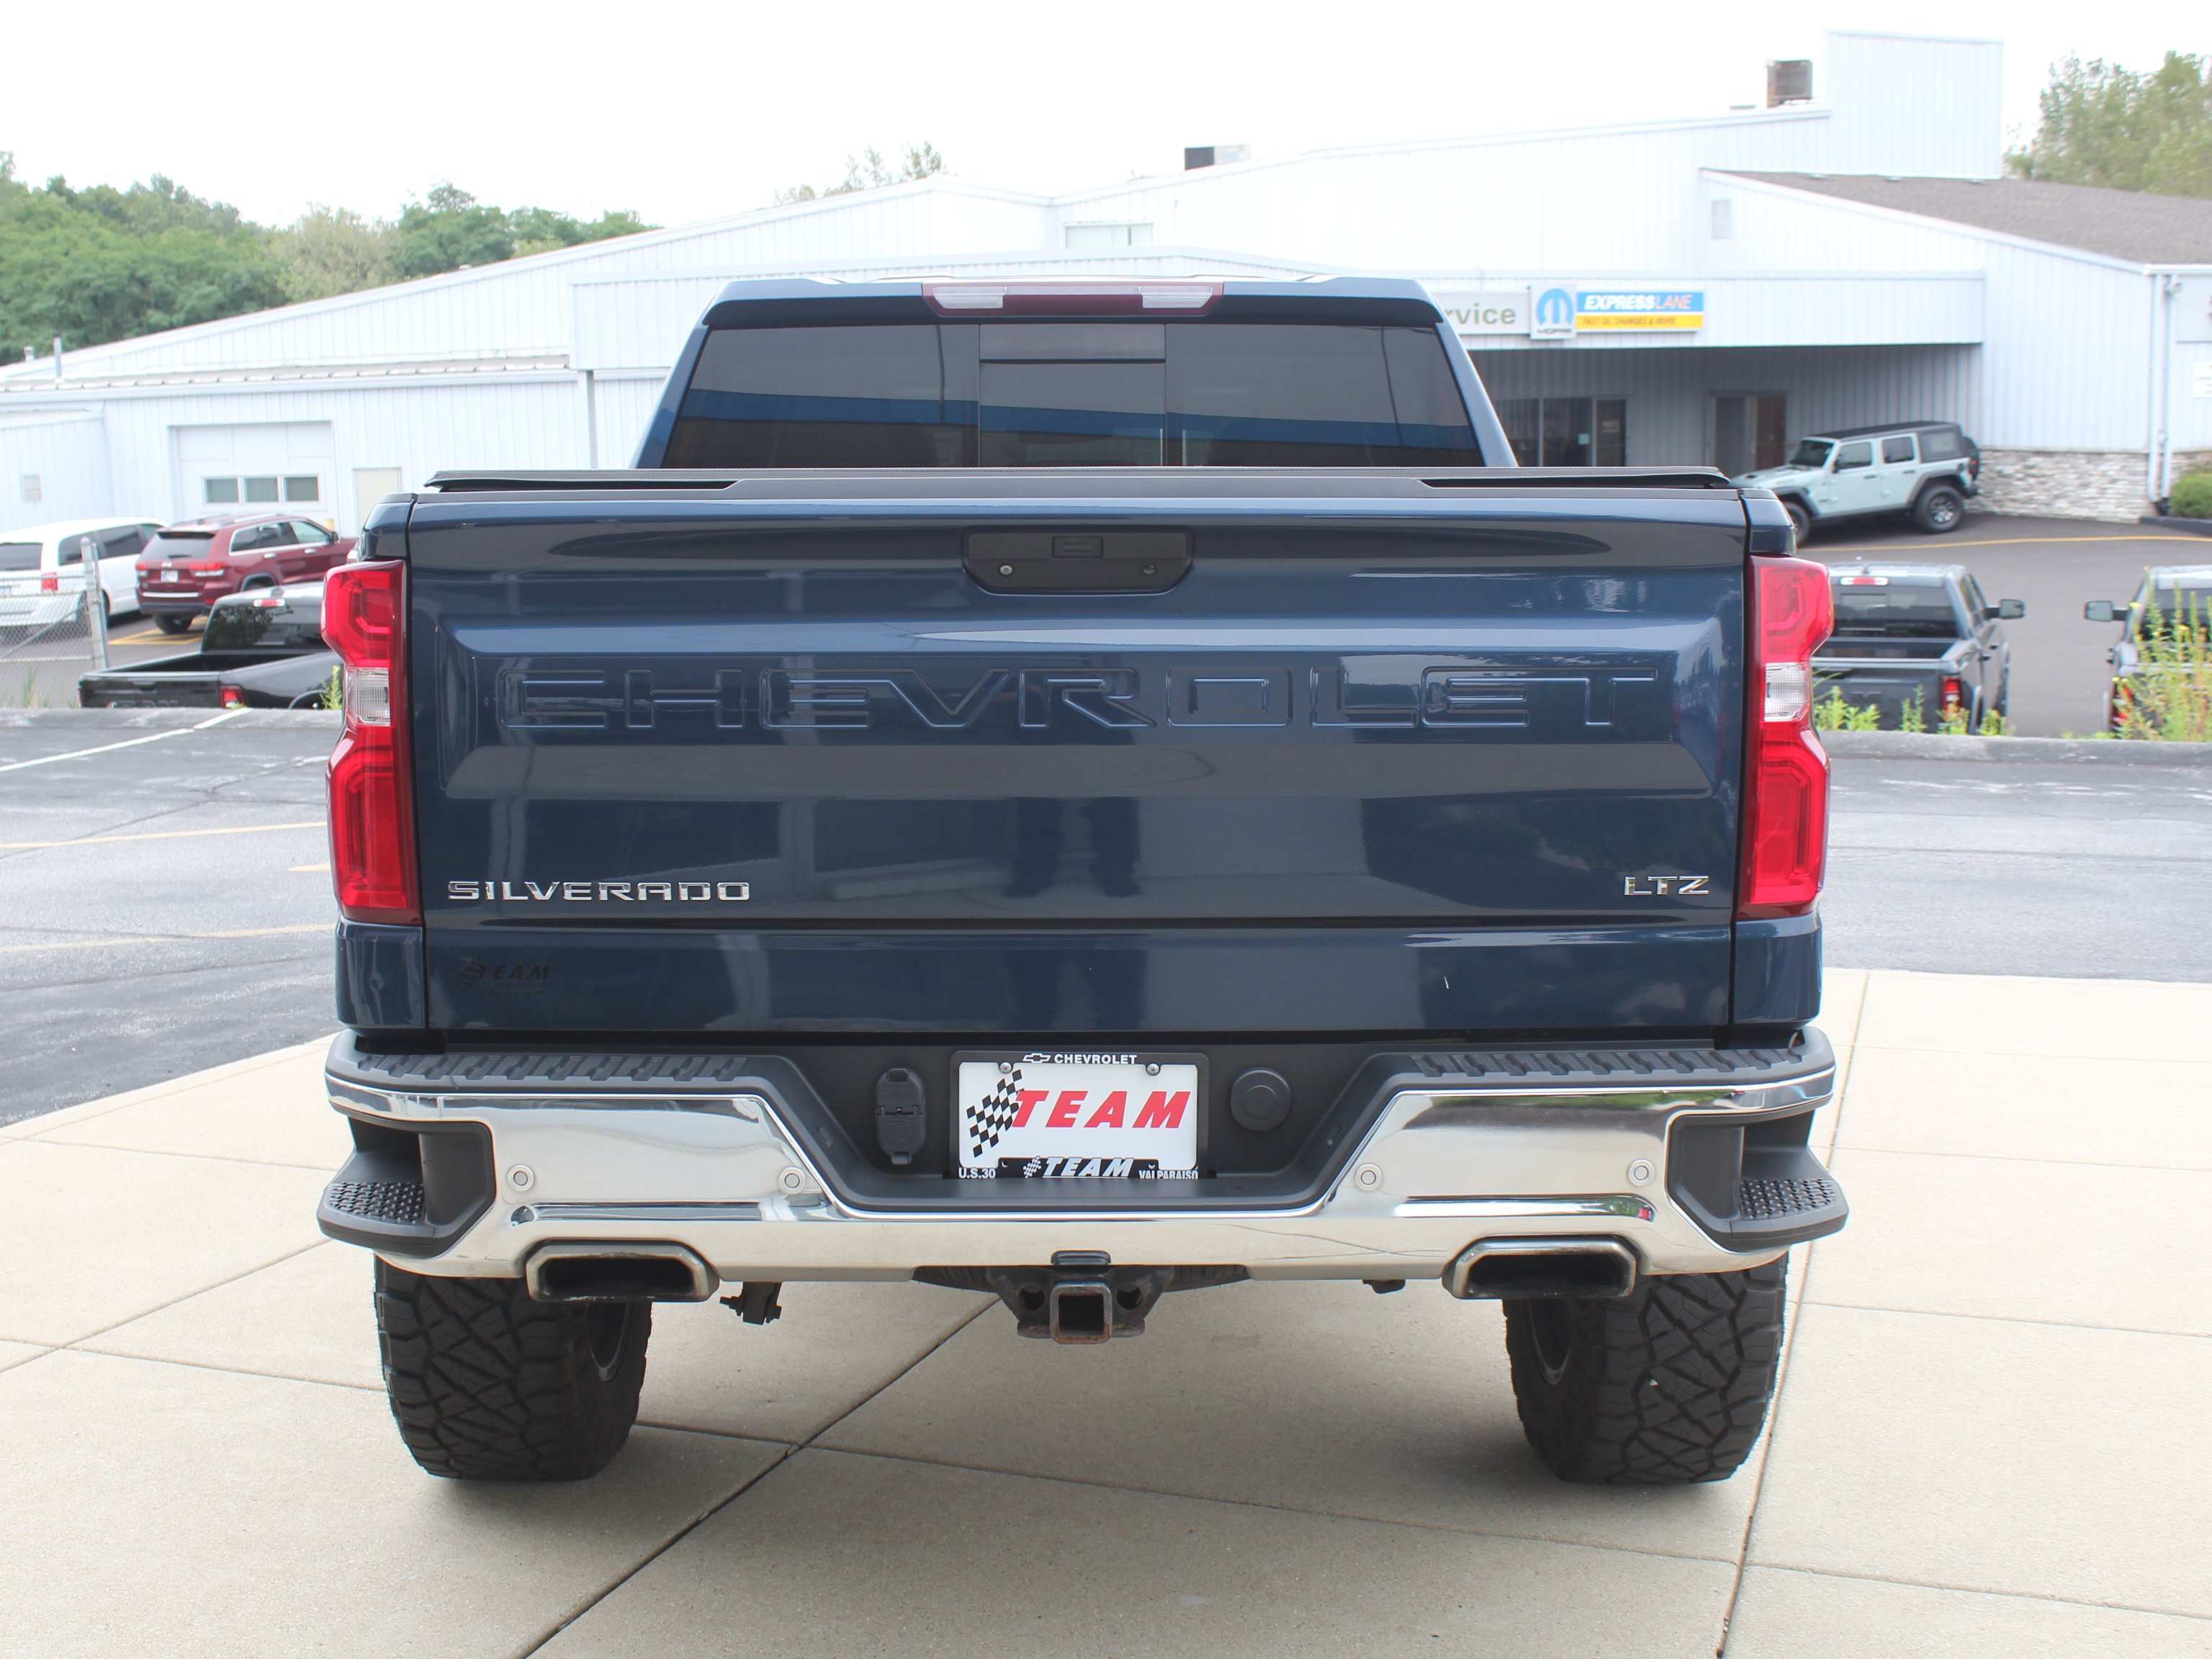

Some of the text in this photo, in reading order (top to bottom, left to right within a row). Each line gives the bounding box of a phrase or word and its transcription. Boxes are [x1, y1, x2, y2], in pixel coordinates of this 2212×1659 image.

[1444, 302, 1516, 324] rvice
[496, 667, 1658, 730] CHEVROLET
[448, 881, 750, 902] SILVERADO
[1624, 875, 1709, 895] LTZ
[478, 964, 552, 980] TEAM
[1053, 1053, 1137, 1065] CHEVROLET
[1011, 1090, 1191, 1129] TEAM
[1042, 1156, 1135, 1178] TEAM
